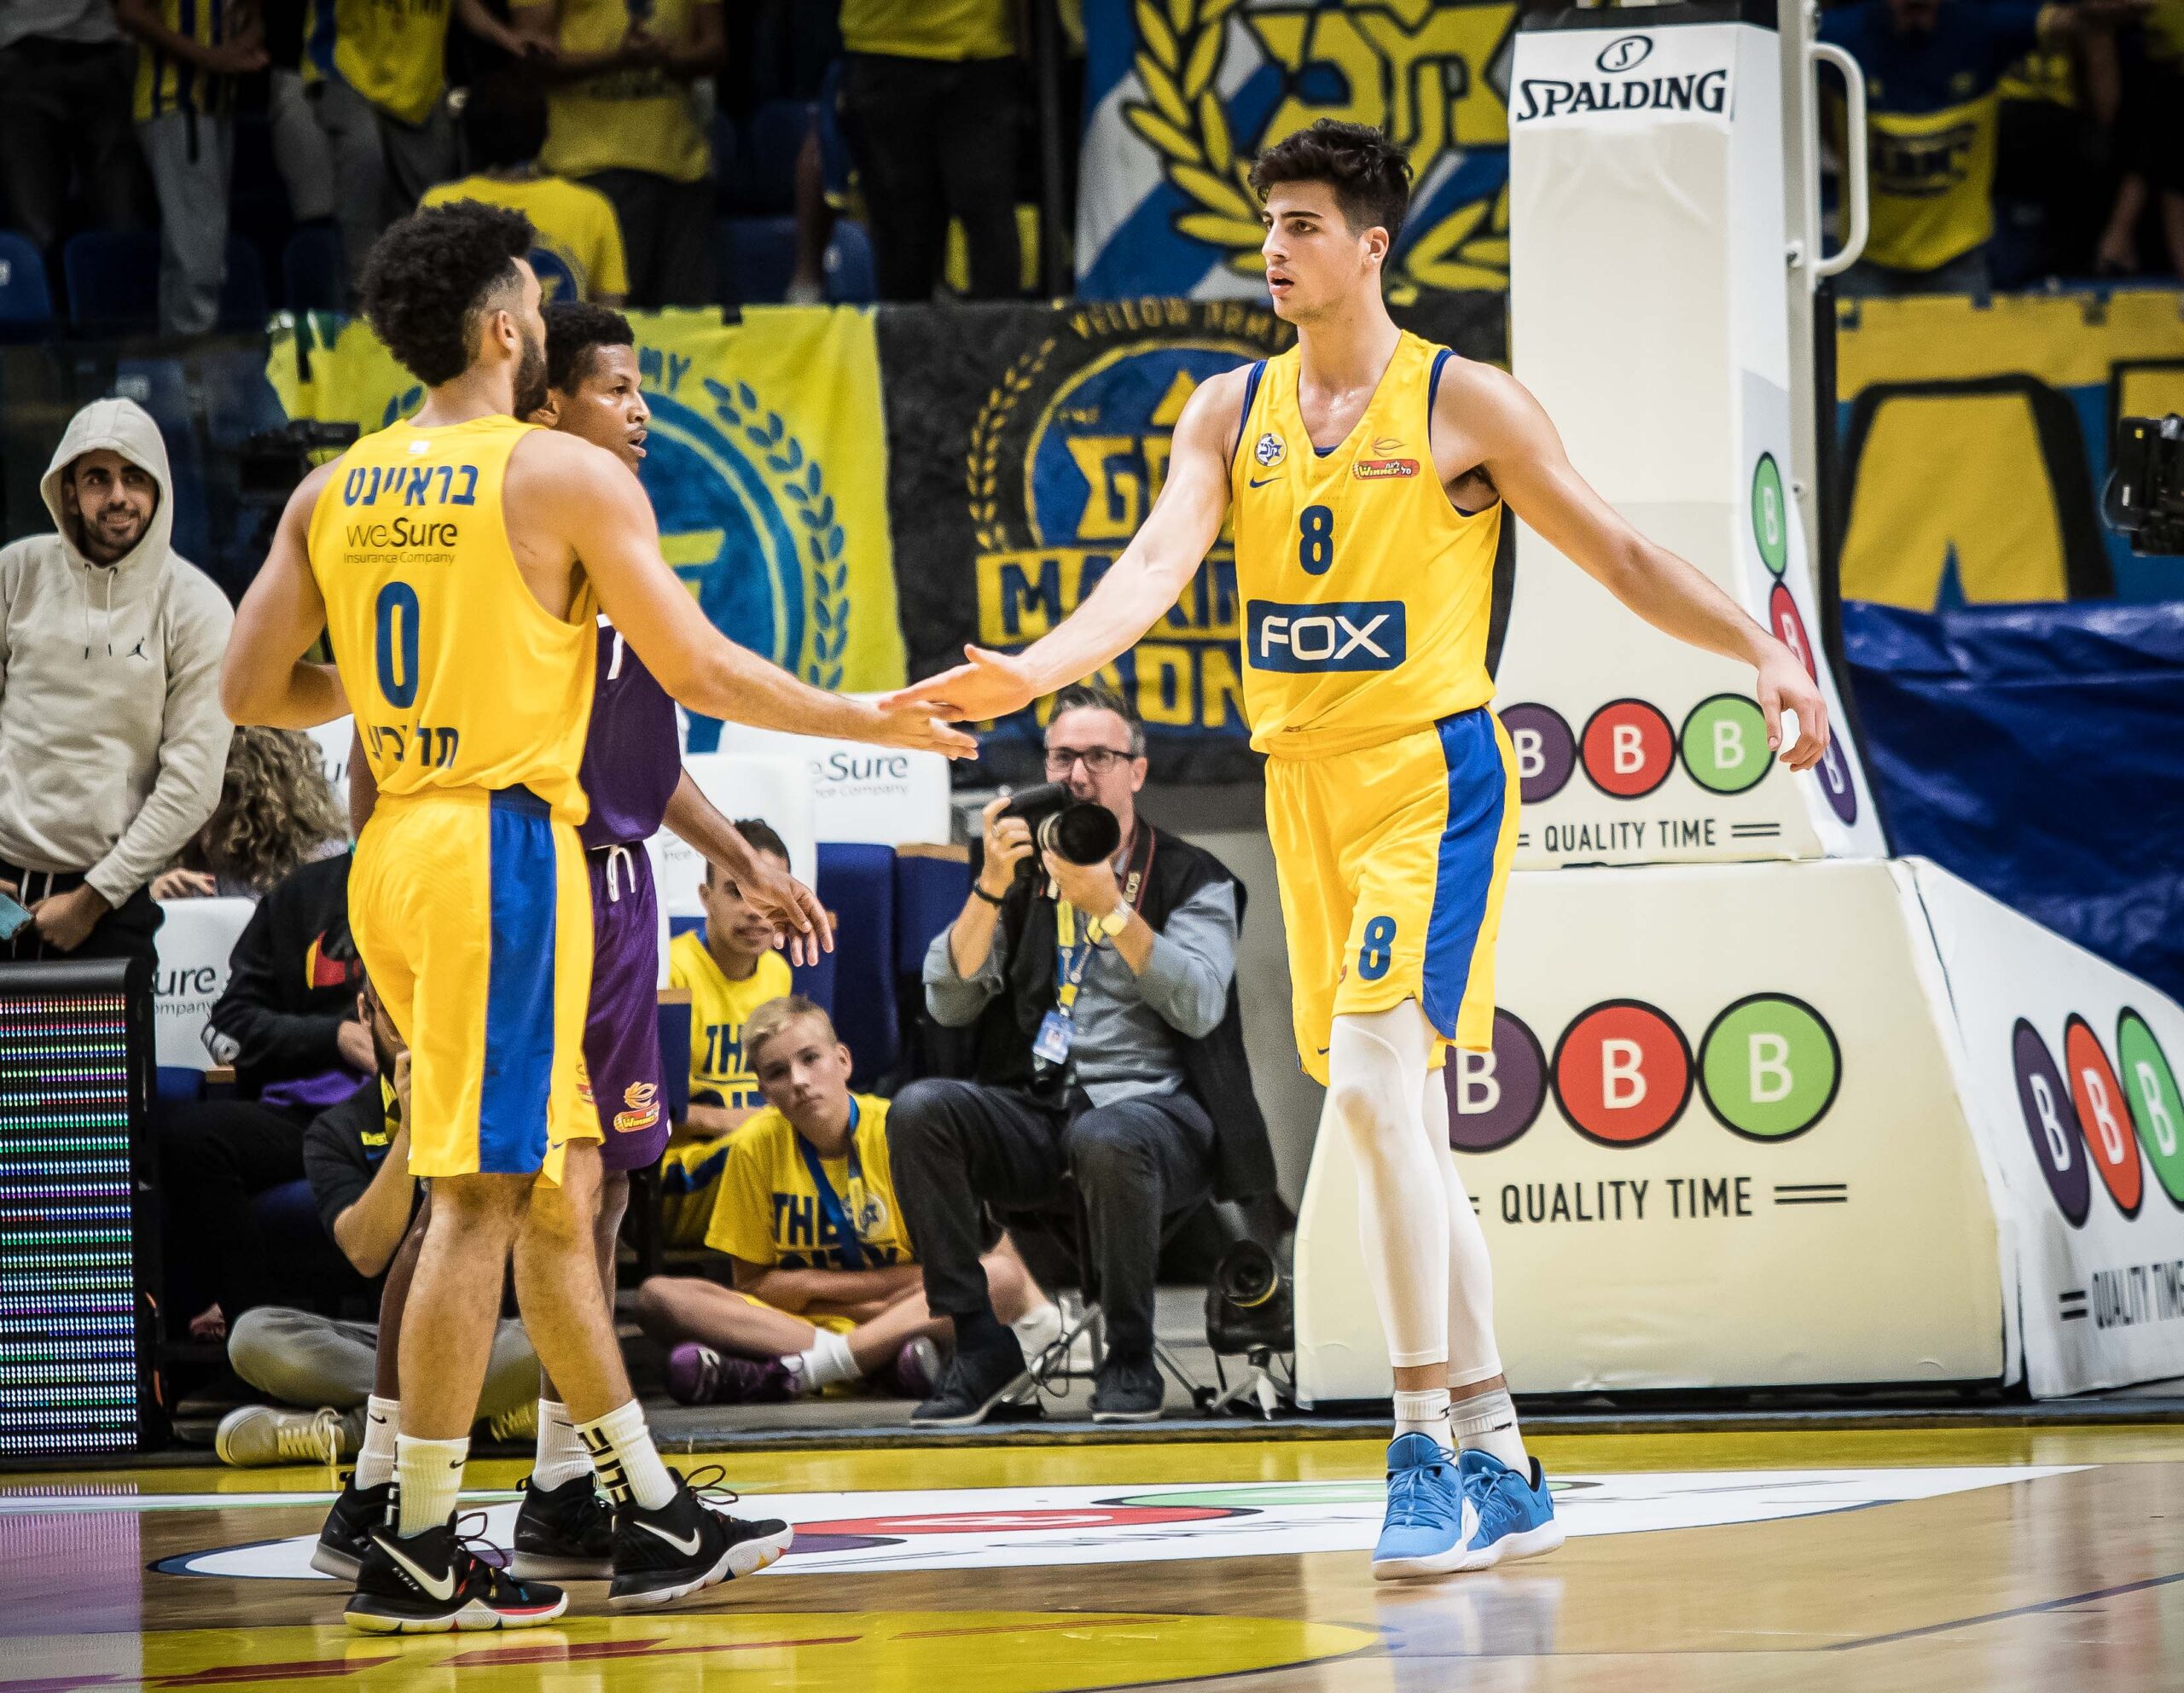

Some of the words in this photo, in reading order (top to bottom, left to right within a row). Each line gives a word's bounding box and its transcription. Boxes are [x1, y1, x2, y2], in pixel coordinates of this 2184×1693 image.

[1516, 69, 1727, 122] SPALDING
[344, 465, 479, 507] בראיינט
[346, 517, 458, 547] weSure
[1299, 505, 1333, 575] 8
[344, 553, 398, 564] Insurance
[400, 552, 455, 567] Company
[375, 581, 419, 709] 0
[1261, 614, 1391, 660] FOX
[1612, 724, 1646, 774] B
[1713, 720, 1745, 768] B
[1544, 821, 1647, 852] QUALITY
[1660, 818, 1716, 848] TIME
[1358, 915, 1397, 980] 8
[154, 966, 216, 996] ure
[702, 1023, 752, 1073] TH
[1456, 1046, 1501, 1114] B
[1601, 1038, 1647, 1109] B
[1749, 1033, 1793, 1103] B
[1501, 1179, 1649, 1224] QUALITY
[1666, 1176, 1753, 1218] TIME
